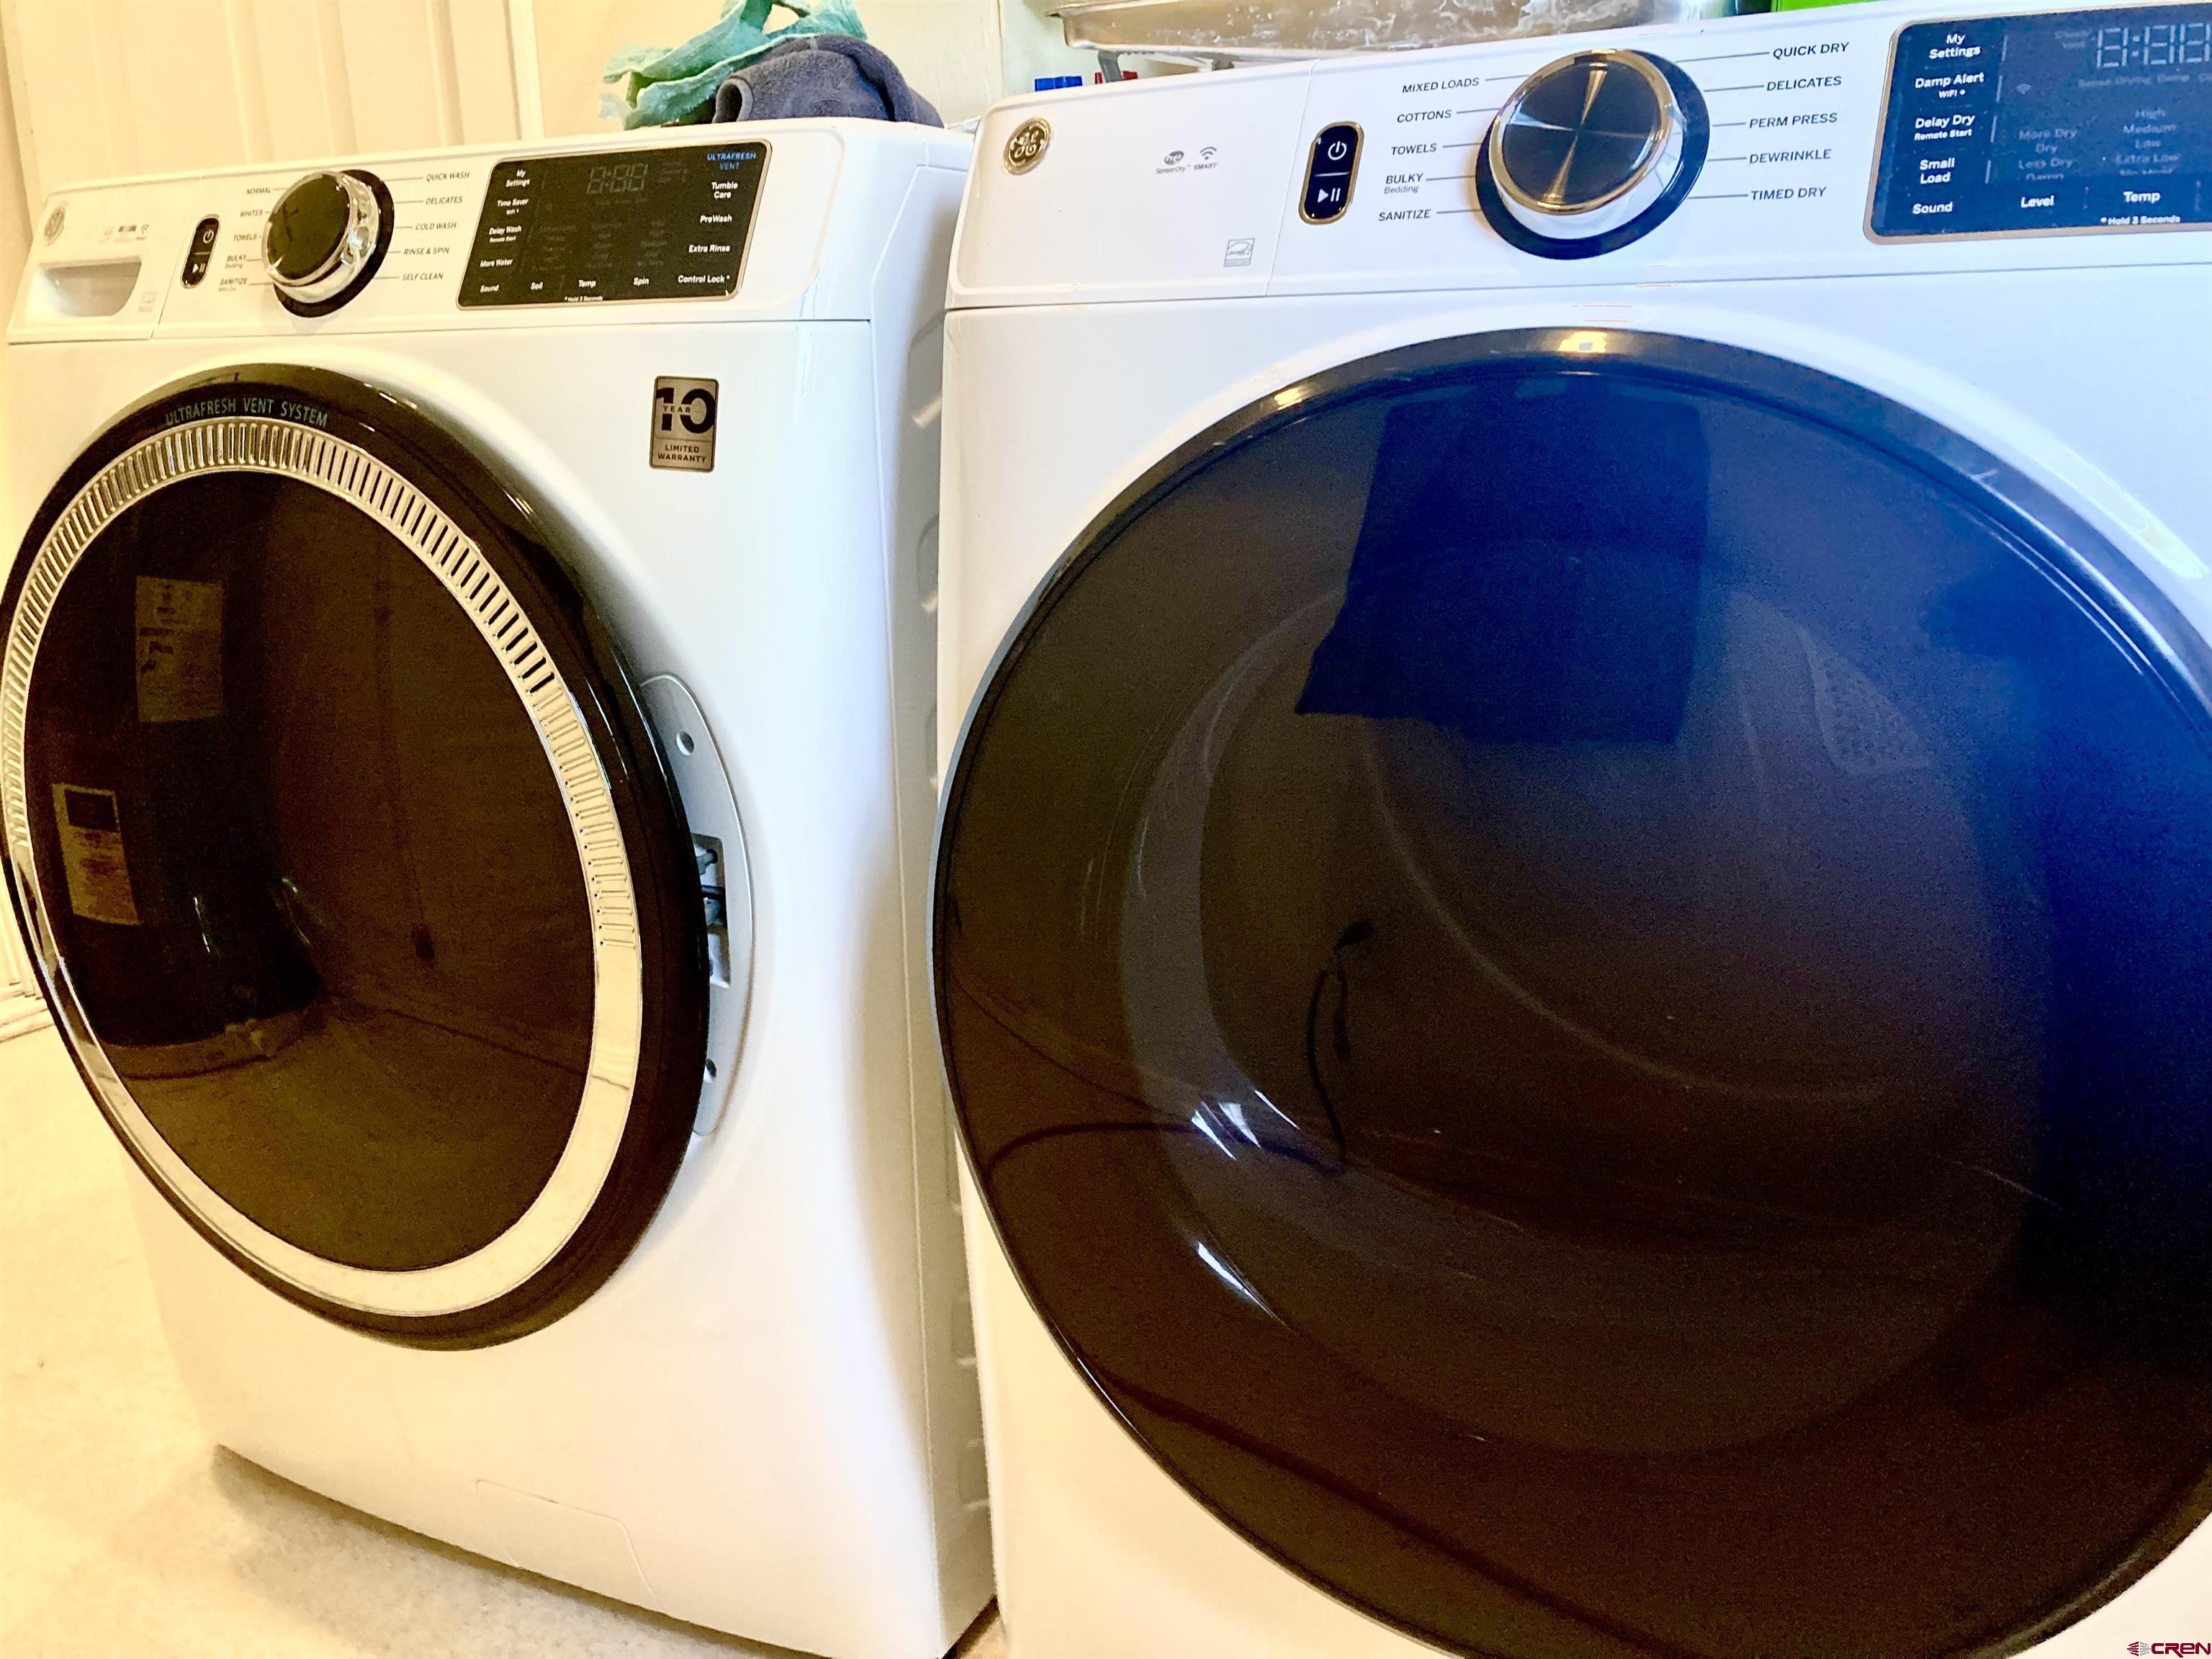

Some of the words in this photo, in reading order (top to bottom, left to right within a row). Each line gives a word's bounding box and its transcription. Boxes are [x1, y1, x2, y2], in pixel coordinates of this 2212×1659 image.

[1946, 33, 1966, 45] My
[1773, 45, 1817, 60] QUICK
[1820, 42, 1850, 54] DRY
[1929, 45, 1981, 59] Settings
[1402, 81, 1439, 94] MIXED
[1441, 77, 1480, 90] LOADS
[1766, 76, 1842, 91] DELICATES
[1915, 76, 1951, 89] Damp
[1953, 72, 1984, 84] Alert
[1397, 109, 1452, 123] COTTONS
[1749, 116, 1788, 129] PERM
[1791, 112, 1838, 126] PRESS
[1915, 117, 1950, 130] Delay
[1953, 114, 1975, 127] Dry
[1915, 131, 1948, 141] Remote
[1949, 128, 1973, 138] Start
[2018, 130, 2051, 140] More
[2055, 127, 2077, 139] Dry
[2123, 123, 2177, 135] Medium
[1391, 143, 1437, 156] TOWELS
[2035, 143, 2058, 154] Dry
[707, 153, 756, 161] ULTRAFRESH
[1749, 149, 1832, 164] DEWRINKLE
[2051, 157, 2072, 168] Dry
[719, 162, 739, 171] VENT
[1194, 162, 1217, 171] SMART
[1920, 157, 1955, 171] Small
[426, 173, 447, 182] QUICK
[516, 169, 526, 178] My
[1385, 173, 1424, 184] BULKY
[1920, 171, 1951, 184] Load
[505, 179, 530, 188] Settings
[711, 181, 738, 190] Tumble
[1384, 184, 1419, 194] Bedding
[1751, 188, 1794, 201] TIMED
[1797, 186, 1827, 198] DRY
[2123, 191, 2161, 204] Temp
[426, 196, 463, 204] DELICATES
[2020, 195, 2055, 209] Level
[1912, 202, 1953, 215] Sound
[700, 215, 732, 223] PreWash
[1378, 209, 1431, 222] SANITIZE
[2108, 217, 2130, 225] Hold
[2140, 215, 2180, 224] Seconds
[489, 227, 505, 235] Delay
[506, 225, 521, 233] Wash
[688, 244, 708, 253] Extra
[709, 243, 731, 252] Rinse
[530, 282, 544, 290] Soil
[578, 279, 596, 288] Temp
[634, 276, 649, 287] Spin
[480, 284, 500, 292] Sound
[165, 397, 236, 426] ULTRAFRESH
[243, 397, 274, 414] VENT
[279, 401, 328, 428] SYSTEM
[656, 387, 716, 434] 10
[665, 444, 700, 453] LIMITED
[657, 453, 707, 463] WARRANTY
